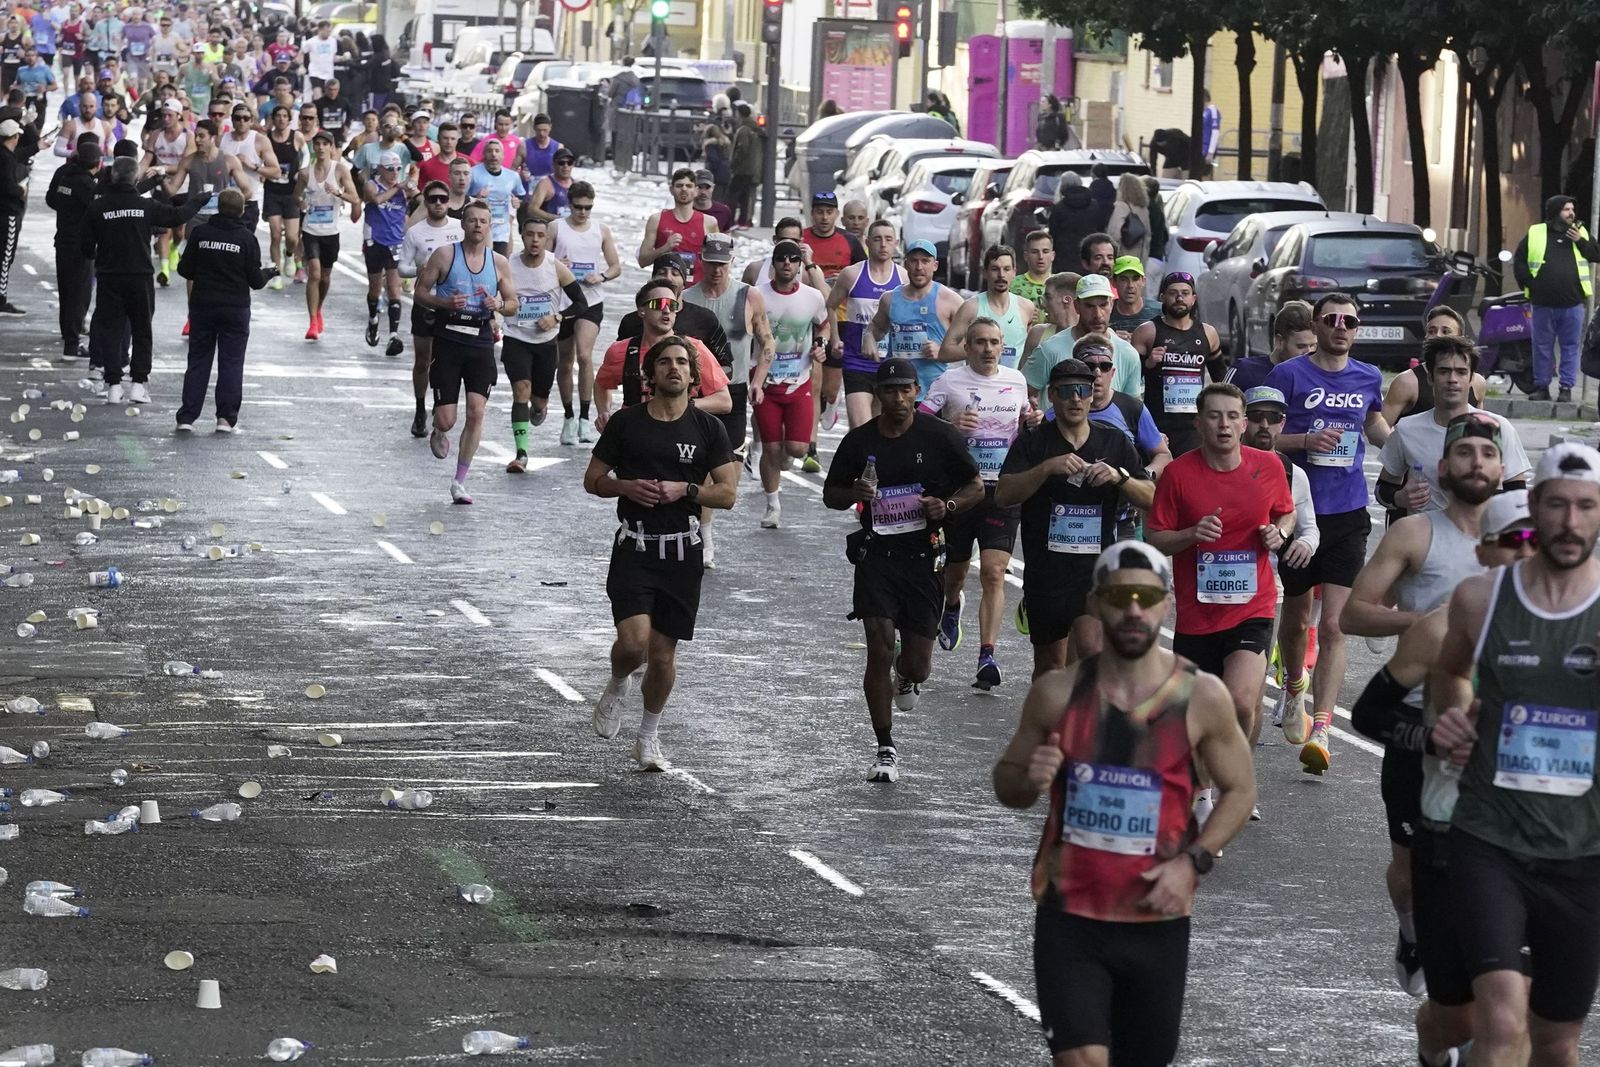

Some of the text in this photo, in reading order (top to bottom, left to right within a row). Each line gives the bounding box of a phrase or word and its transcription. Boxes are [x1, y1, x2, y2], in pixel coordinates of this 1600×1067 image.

[103, 209, 145, 220] VOLUNTEER
[198, 240, 241, 253] VOLUNTEER
[1358, 328, 1378, 338] 249
[896, 342, 921, 351] FARLEY
[1327, 421, 1355, 430] ZURICH
[676, 443, 696, 459] W
[1049, 533, 1076, 543] AFONSO
[1218, 553, 1250, 561] ZURICH
[1206, 580, 1249, 591] GEORGE
[1531, 711, 1587, 727] ZURICH
[1500, 753, 1592, 775] TIAGO VIANA
[1099, 770, 1151, 787] ZURICH
[1068, 807, 1154, 834] PEDRO GIL
